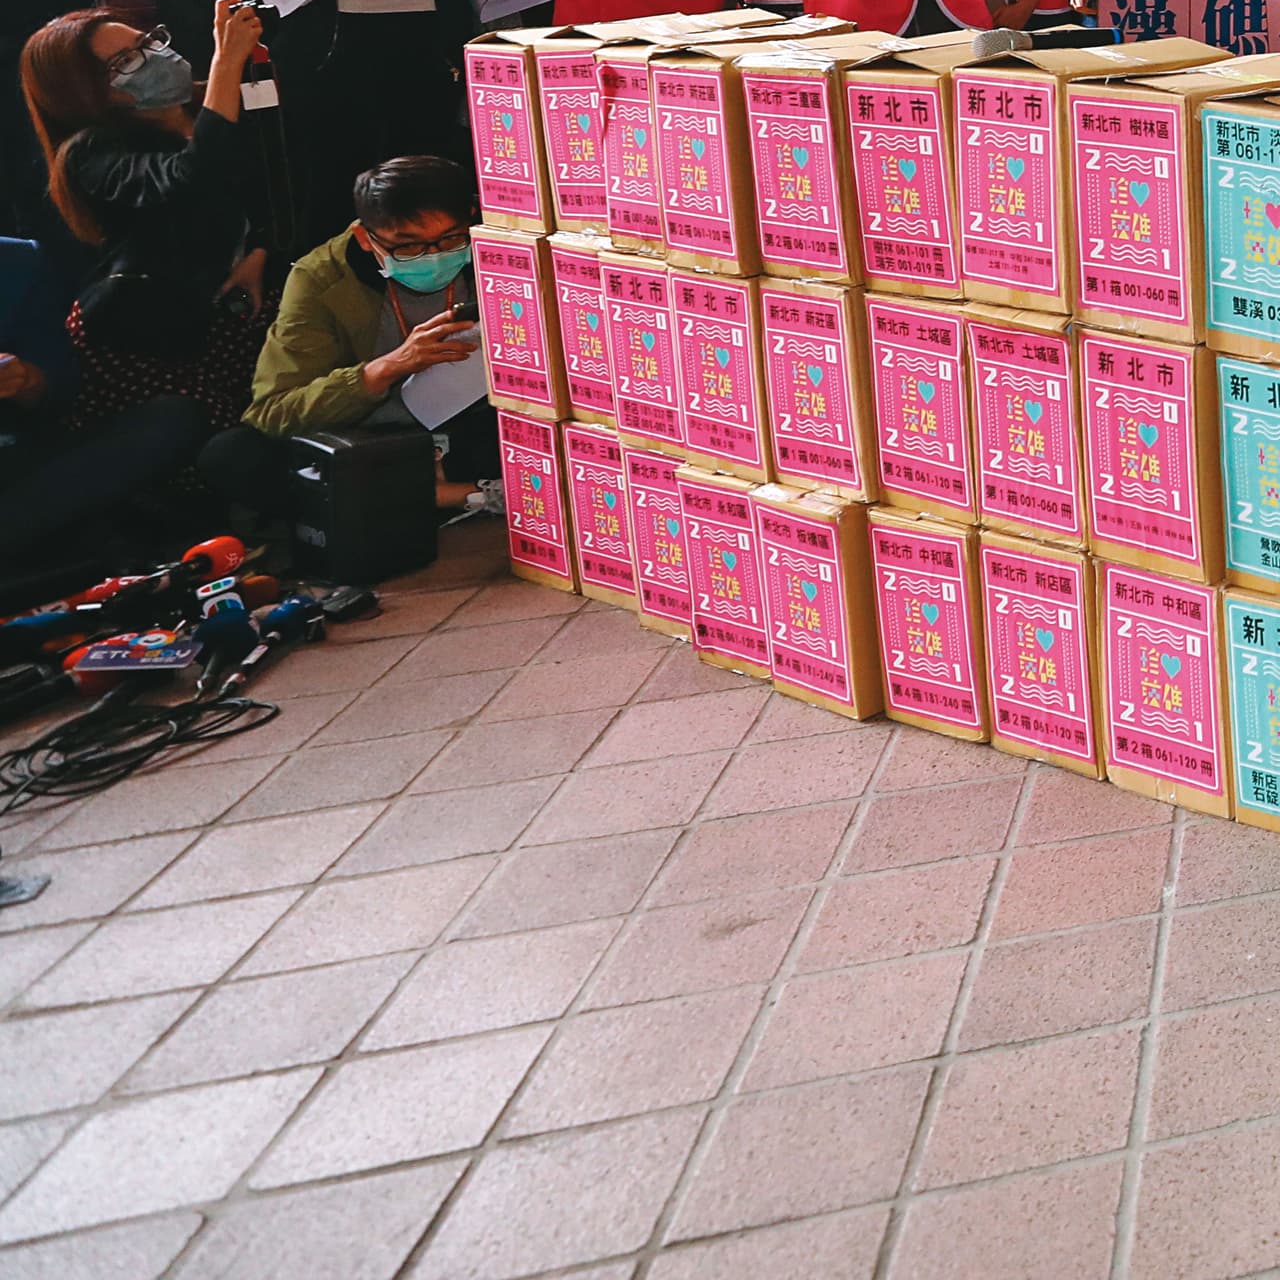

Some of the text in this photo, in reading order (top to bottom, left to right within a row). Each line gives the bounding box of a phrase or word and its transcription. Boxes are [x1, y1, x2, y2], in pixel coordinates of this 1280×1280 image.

[1216, 120, 1260, 145] 新北市
[1217, 138, 1231, 157] 第
[1251, 770, 1278, 793] 新店
